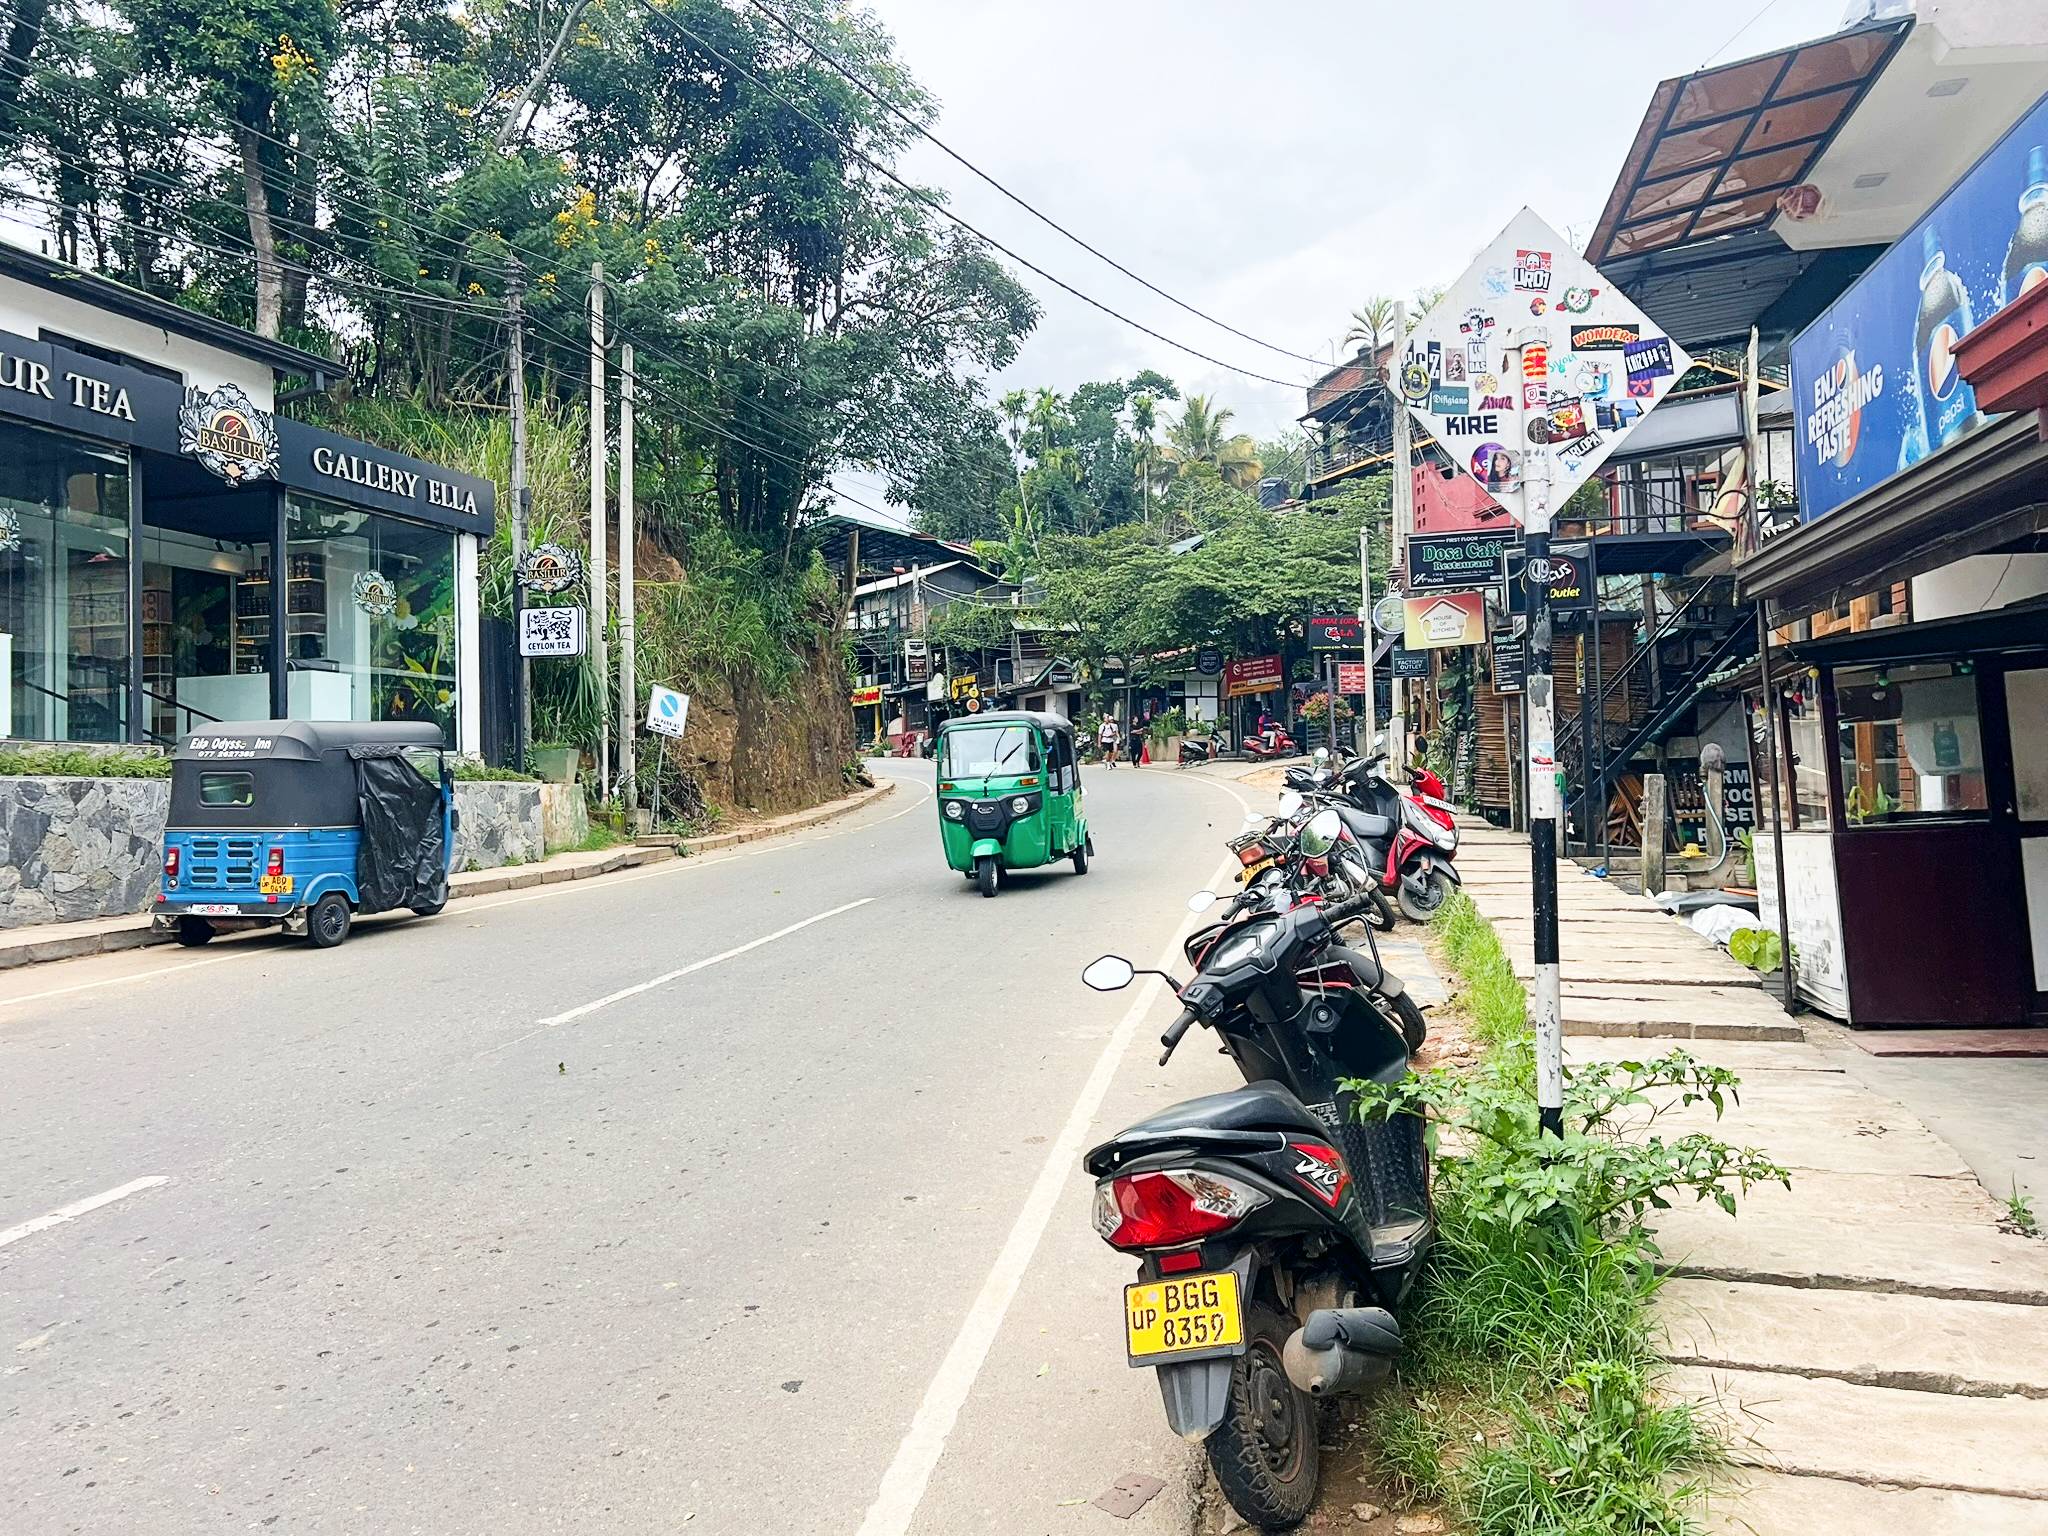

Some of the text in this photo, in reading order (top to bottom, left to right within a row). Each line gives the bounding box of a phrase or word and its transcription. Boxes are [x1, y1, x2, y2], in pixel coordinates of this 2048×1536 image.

[66, 371, 137, 422] TEA
[1807, 363, 1884, 445] REFRESHING
[1446, 414, 1498, 436] KIRE
[1937, 392, 1965, 436] pepsi
[201, 430, 264, 463] BASILUR
[1815, 418, 1851, 466] TASTE
[313, 447, 479, 516] GALLERY ELLA
[1422, 545, 1463, 563] Dosa
[1433, 558, 1494, 571] Restaurant
[528, 568, 567, 579] BASILUR
[1550, 586, 1581, 599] Outlet
[528, 641, 571, 650] CEYLON TEA
[253, 737, 272, 750] Inn
[1164, 1279, 1219, 1313] BGG
[1132, 1308, 1157, 1330] UP
[1163, 1312, 1224, 1347] 8359
